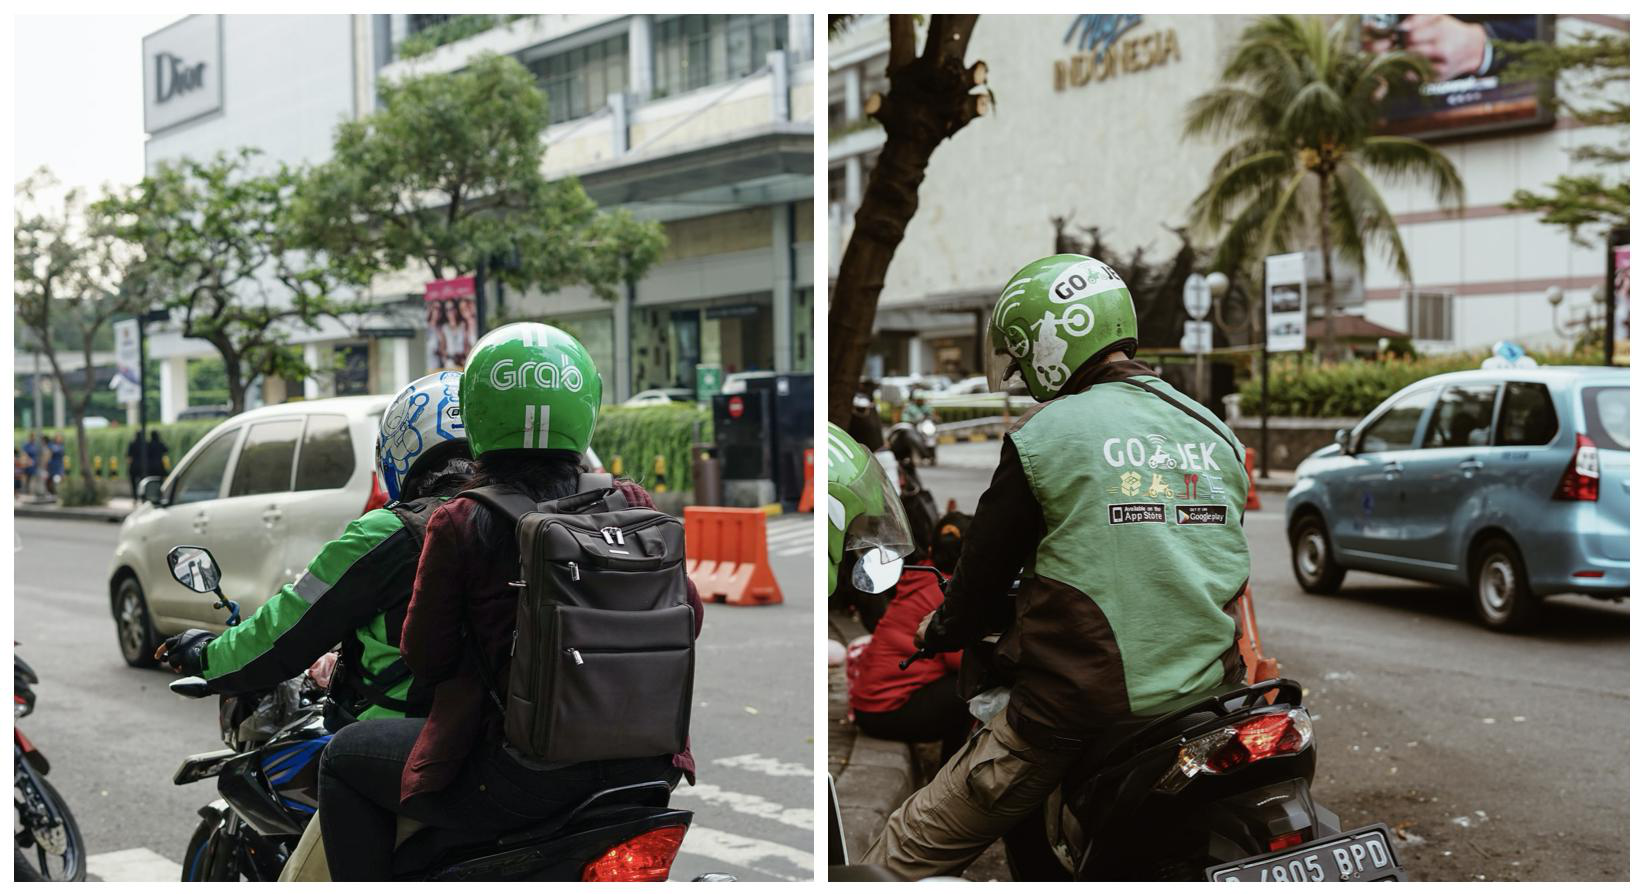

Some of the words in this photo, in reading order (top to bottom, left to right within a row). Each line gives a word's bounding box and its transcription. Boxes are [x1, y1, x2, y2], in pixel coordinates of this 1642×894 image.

[154, 51, 205, 103] Dior
[1053, 28, 1181, 92] INDONESIA
[1055, 274, 1087, 300] GO
[1101, 266, 1121, 280] JE
[490, 353, 583, 392] Grab
[1103, 437, 1146, 468] GO
[1177, 442, 1221, 471] JEK
[1125, 512, 1143, 521] App
[1143, 511, 1163, 520] Store
[1333, 840, 1388, 876] BPD
